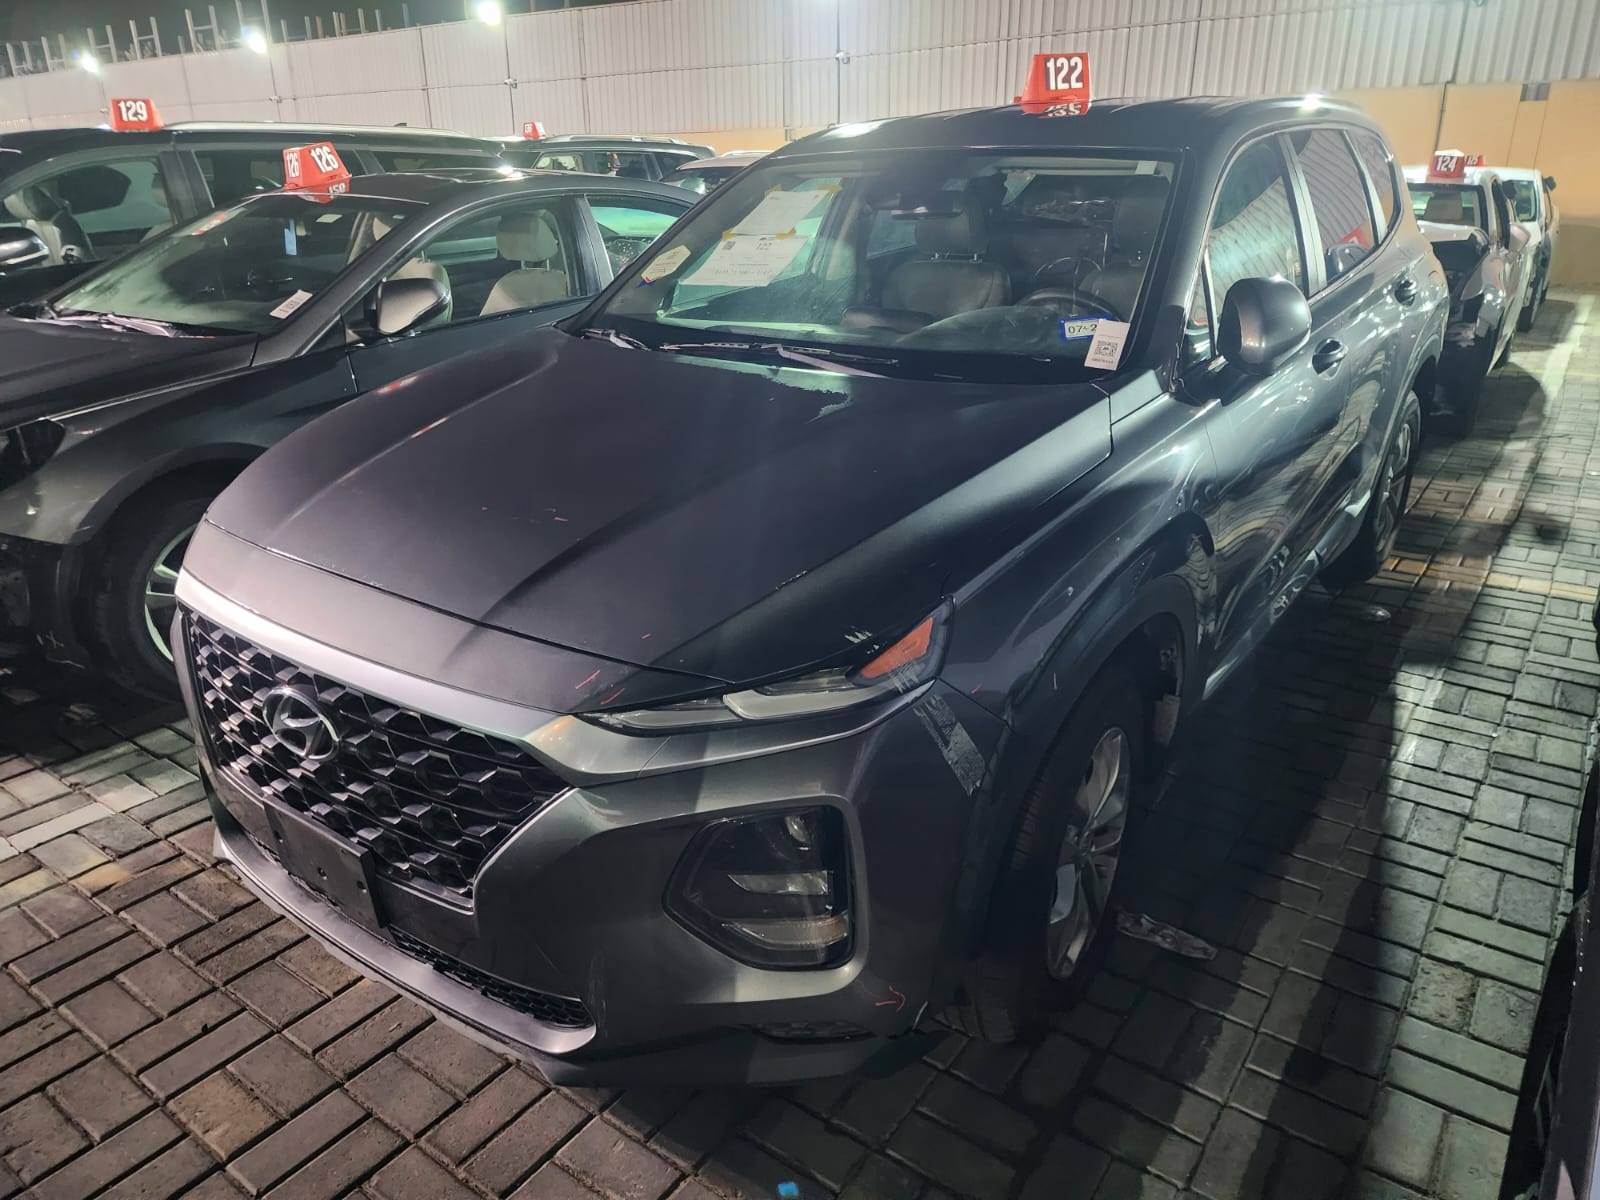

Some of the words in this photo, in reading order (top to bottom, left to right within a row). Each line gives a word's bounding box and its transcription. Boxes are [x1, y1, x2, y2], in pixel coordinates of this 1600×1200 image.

[1046, 56, 1083, 90] 122
[117, 100, 148, 122] 129
[286, 152, 300, 178] 126
[310, 145, 339, 173] 126
[1436, 156, 1457, 172] 124
